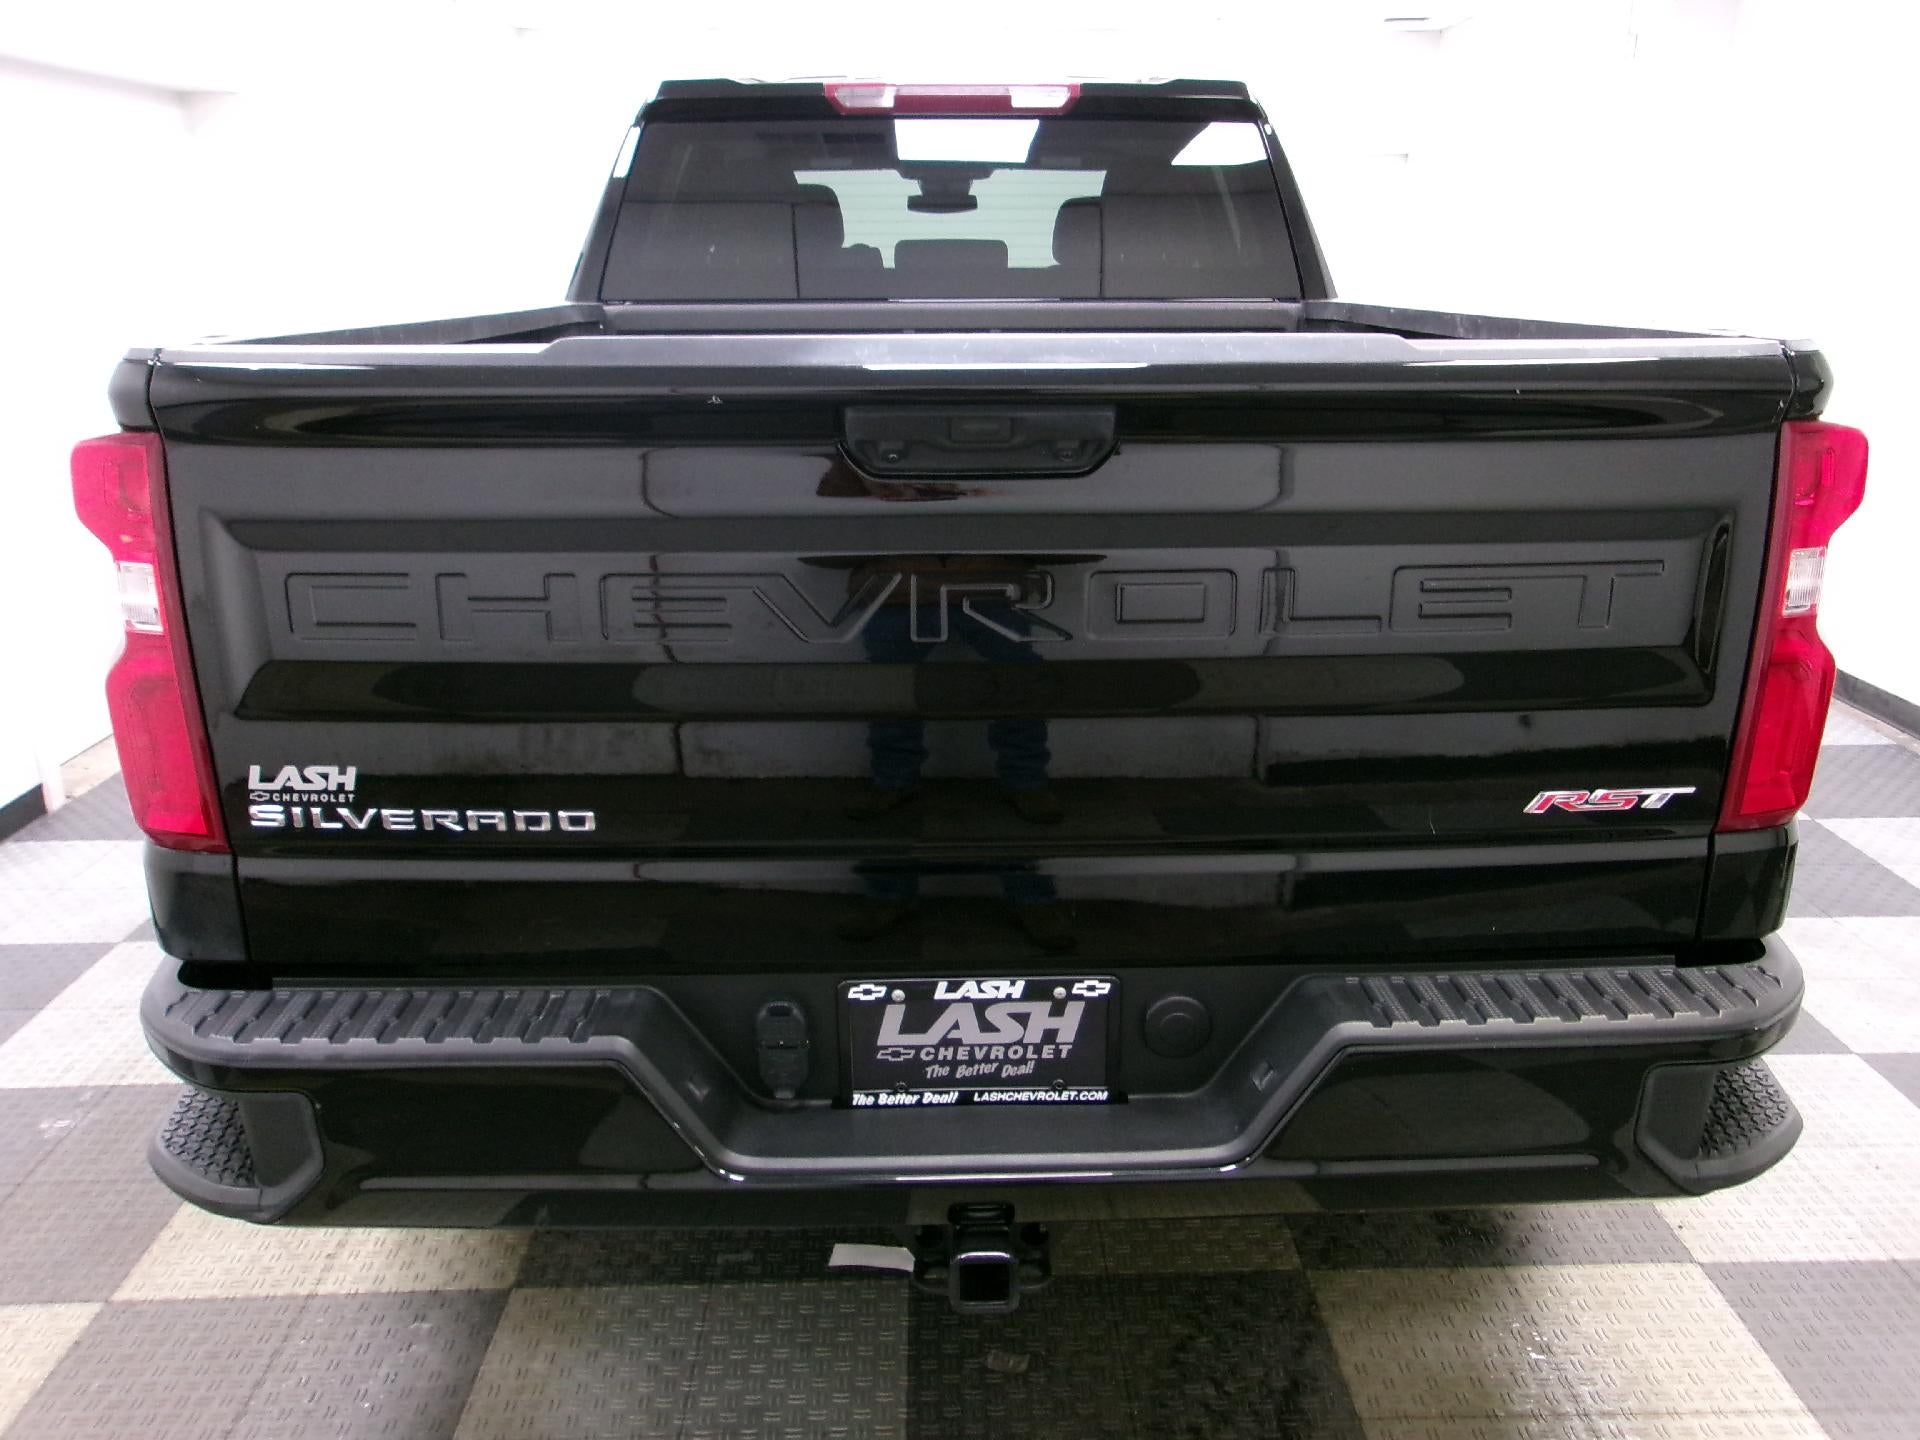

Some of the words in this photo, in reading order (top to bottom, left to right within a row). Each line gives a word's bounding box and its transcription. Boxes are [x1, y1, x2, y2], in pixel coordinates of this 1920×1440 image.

[284, 559, 1666, 643] CHEVROLET
[248, 765, 357, 791] LASH
[272, 793, 355, 802] CHEVROLET
[1523, 786, 1697, 814] RST
[248, 804, 596, 832] SILVERADO
[934, 980, 1026, 1001] LASH
[876, 1000, 1086, 1046] LASH
[919, 1045, 1073, 1062] CHEVROLET
[925, 1063, 950, 1079] The
[955, 1062, 998, 1079] Better
[1001, 1061, 1035, 1078] Deal!
[852, 1093, 875, 1106] The
[877, 1092, 921, 1106] Better
[922, 1091, 959, 1105] Deal!
[973, 1090, 1109, 1103] LASHCHEVROLET.COM
